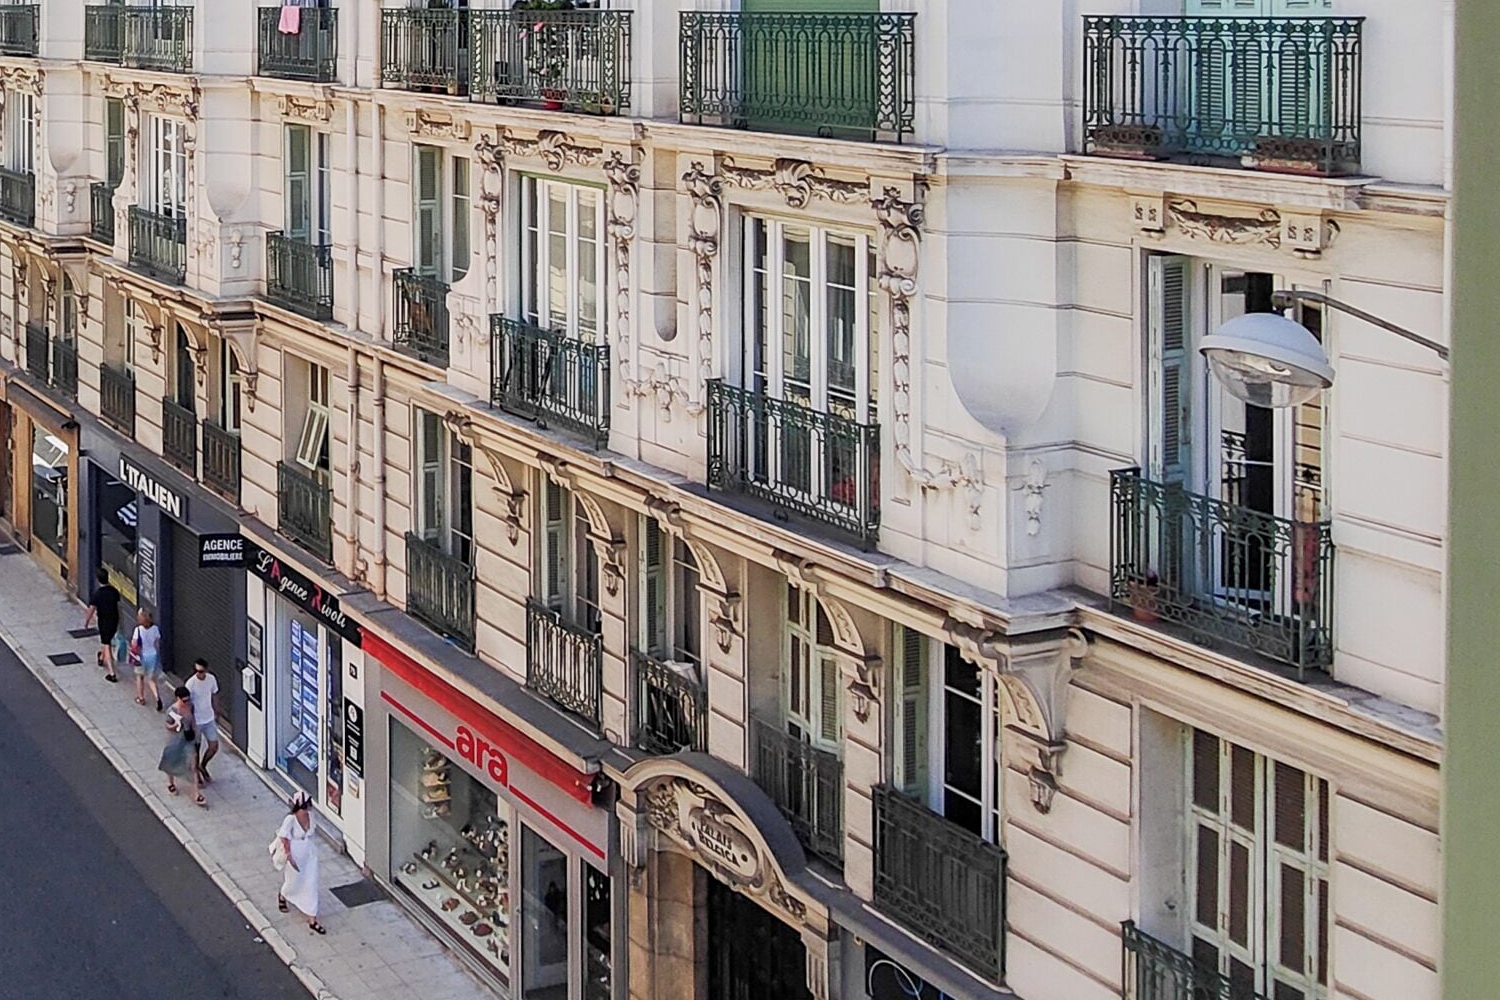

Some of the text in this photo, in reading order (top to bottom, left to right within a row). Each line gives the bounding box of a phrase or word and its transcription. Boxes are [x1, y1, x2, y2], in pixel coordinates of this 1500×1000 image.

[120, 459, 180, 518] L'ITALIEN
[203, 539, 243, 552] AGENCE
[456, 725, 508, 788] ara
[701, 819, 732, 851] PALAIS
